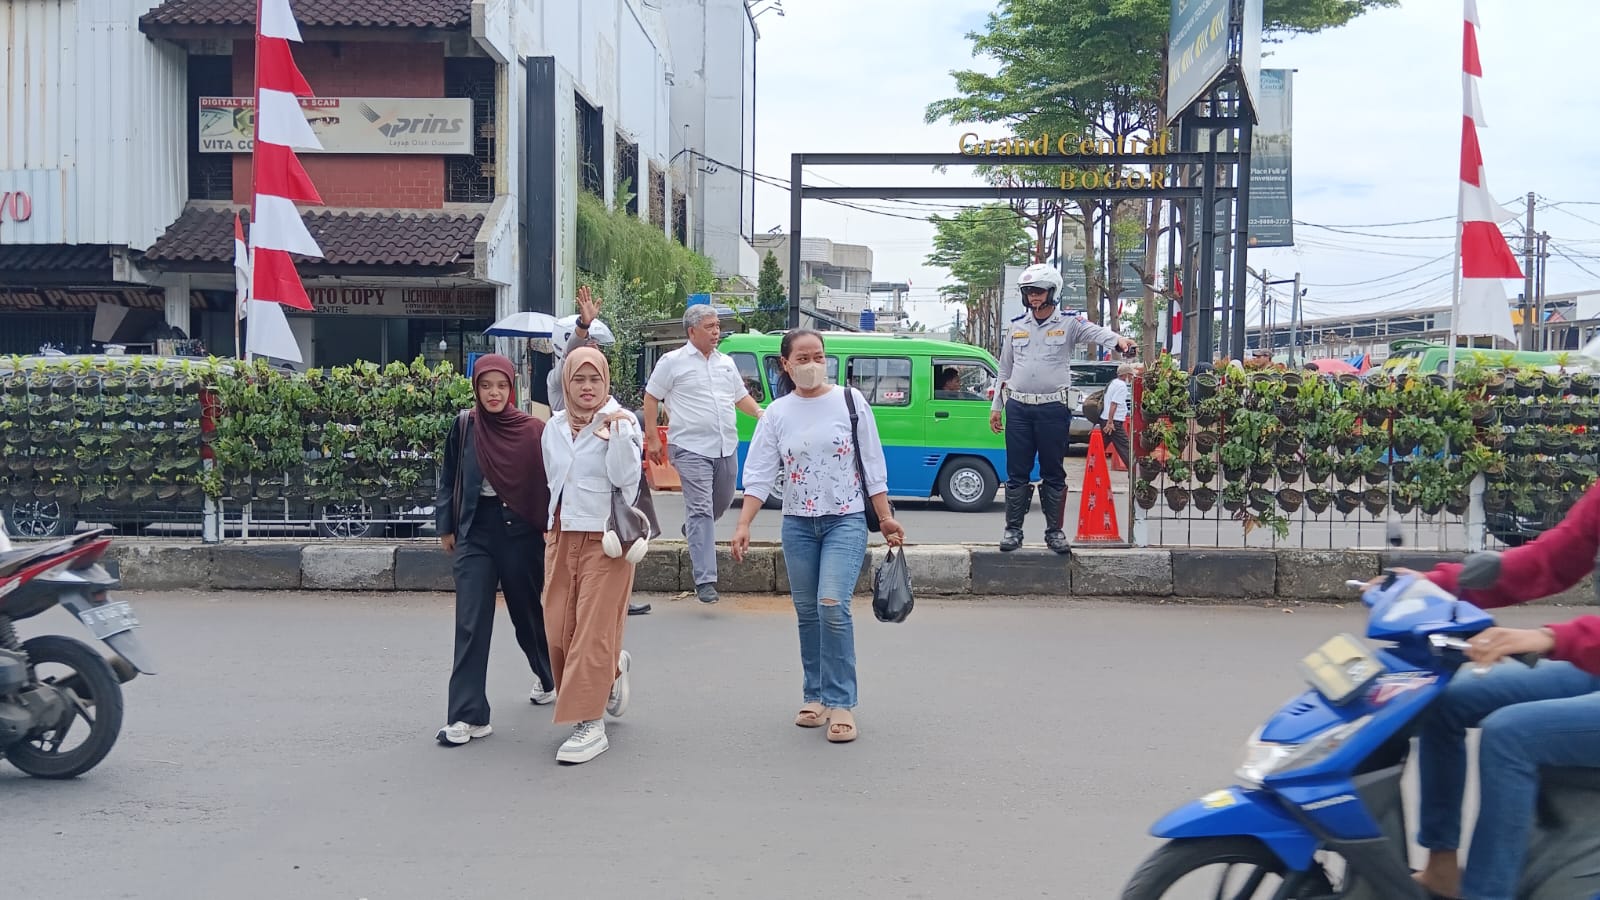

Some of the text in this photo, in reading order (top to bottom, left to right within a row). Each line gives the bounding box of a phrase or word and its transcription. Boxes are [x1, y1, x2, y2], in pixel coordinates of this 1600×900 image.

[203, 139, 255, 150] VITA CO
[958, 131, 1169, 157] Grand Central
[1059, 170, 1165, 191] BOGOR
[122, 289, 208, 310] Digal
[305, 288, 386, 306] OTO COPY
